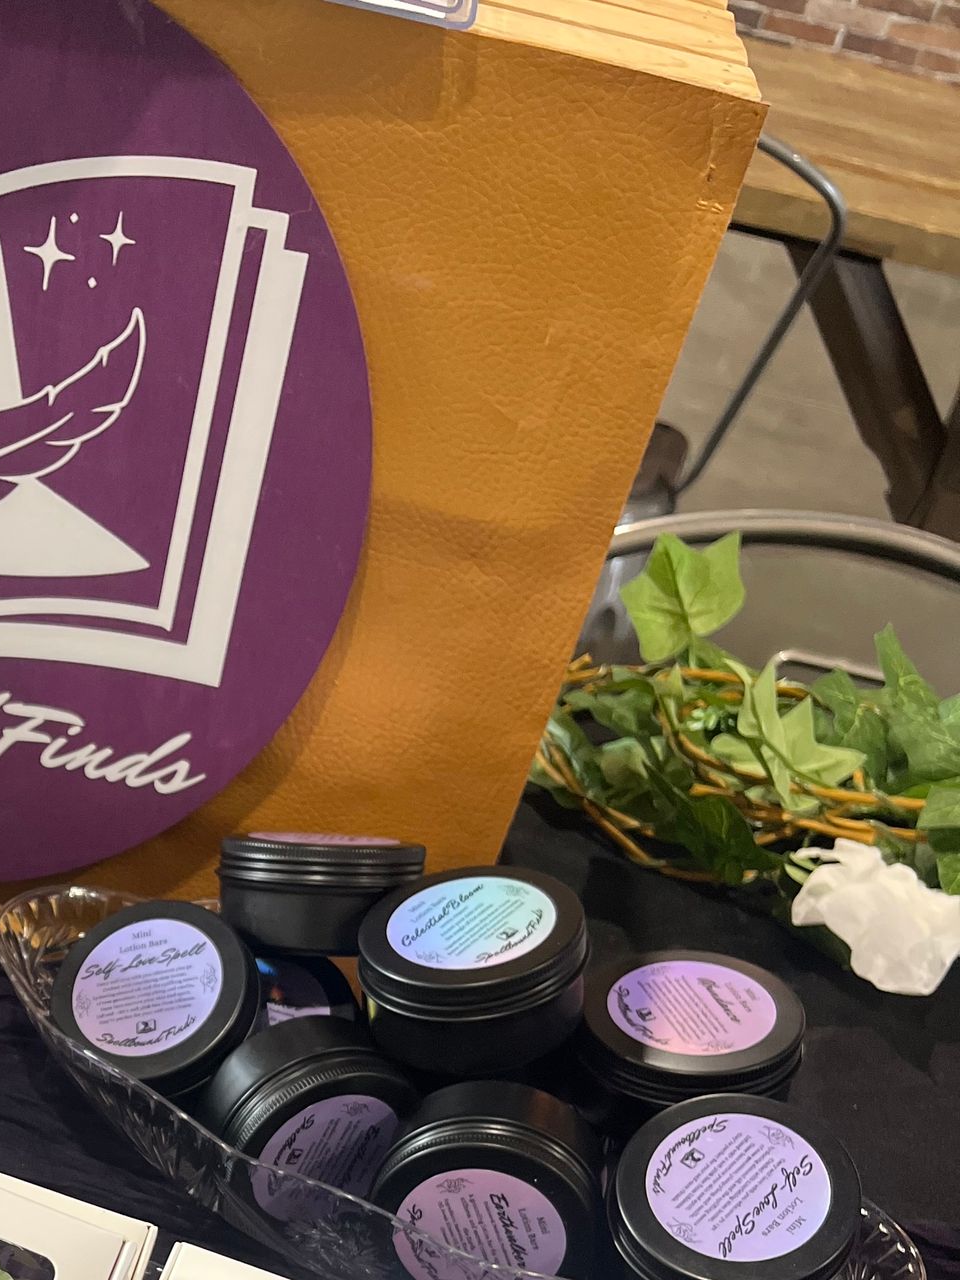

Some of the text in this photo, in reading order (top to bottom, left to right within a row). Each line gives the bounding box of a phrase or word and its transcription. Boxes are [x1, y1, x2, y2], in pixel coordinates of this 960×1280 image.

[401, 902, 450, 947] Celestial
[445, 883, 484, 912] Bloom
[156, 941, 208, 967] Spell
[666, 1117, 729, 1165] Spellbound
[780, 1196, 804, 1221] Lotion
[785, 1216, 807, 1236] Mini
[718, 1213, 756, 1258] Spell
